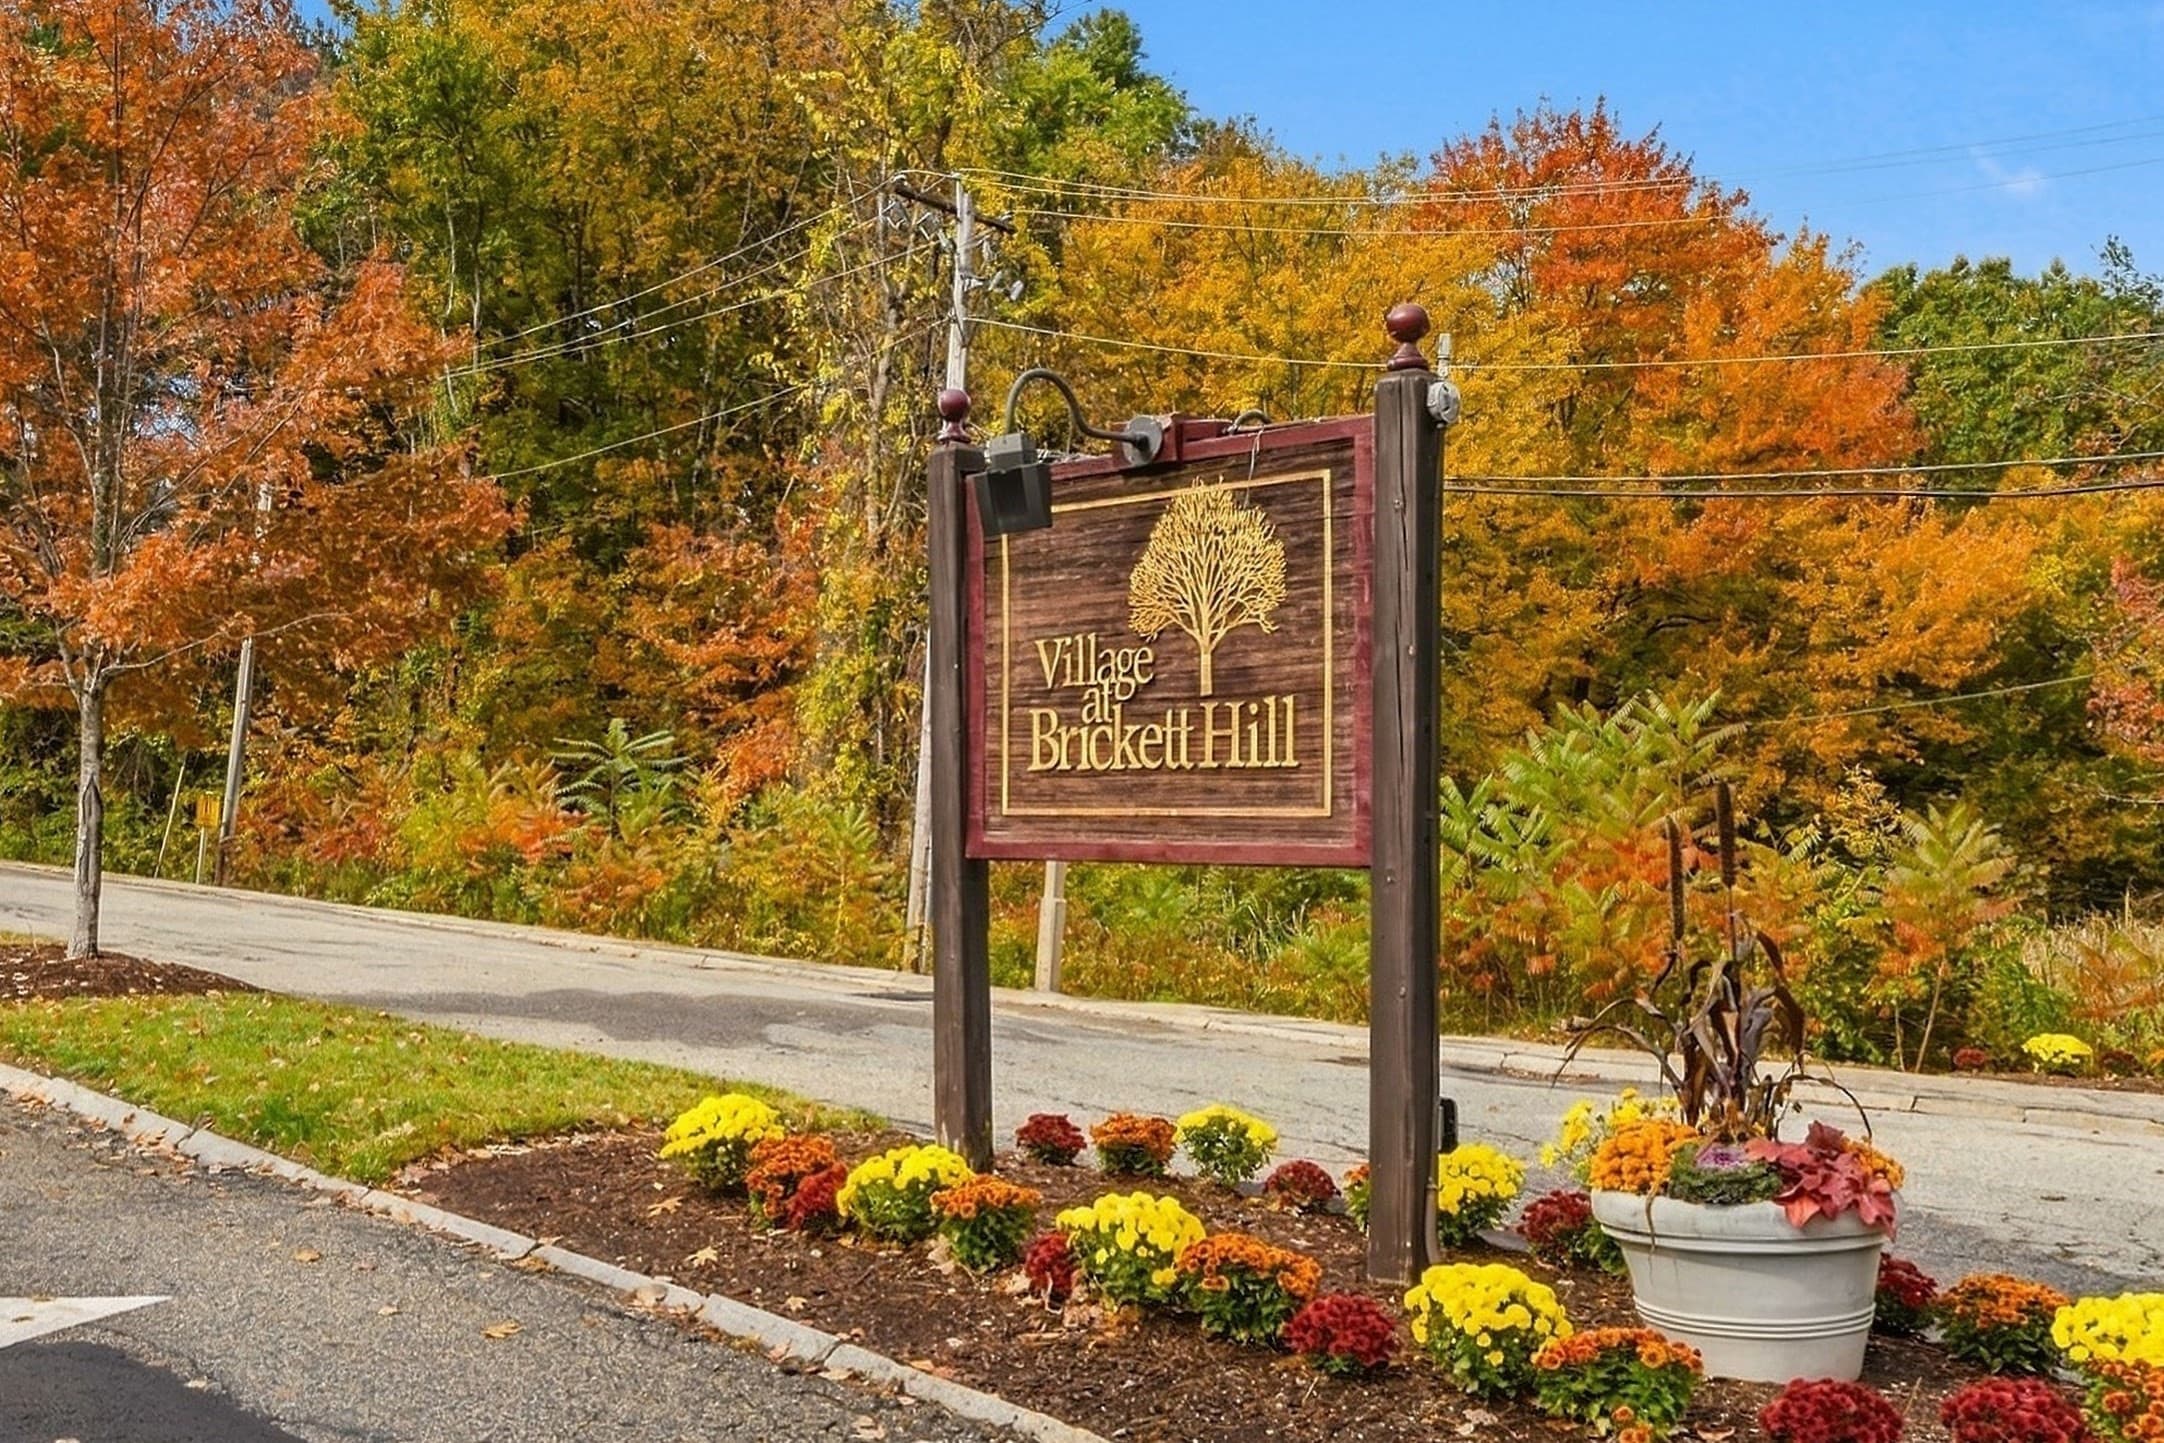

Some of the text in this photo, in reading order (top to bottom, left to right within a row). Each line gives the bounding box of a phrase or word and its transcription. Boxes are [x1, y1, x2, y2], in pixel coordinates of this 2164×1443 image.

[1035, 632, 1154, 701] Village
[1081, 678, 1113, 724] at
[1027, 695, 1300, 772] Brickett Hill
